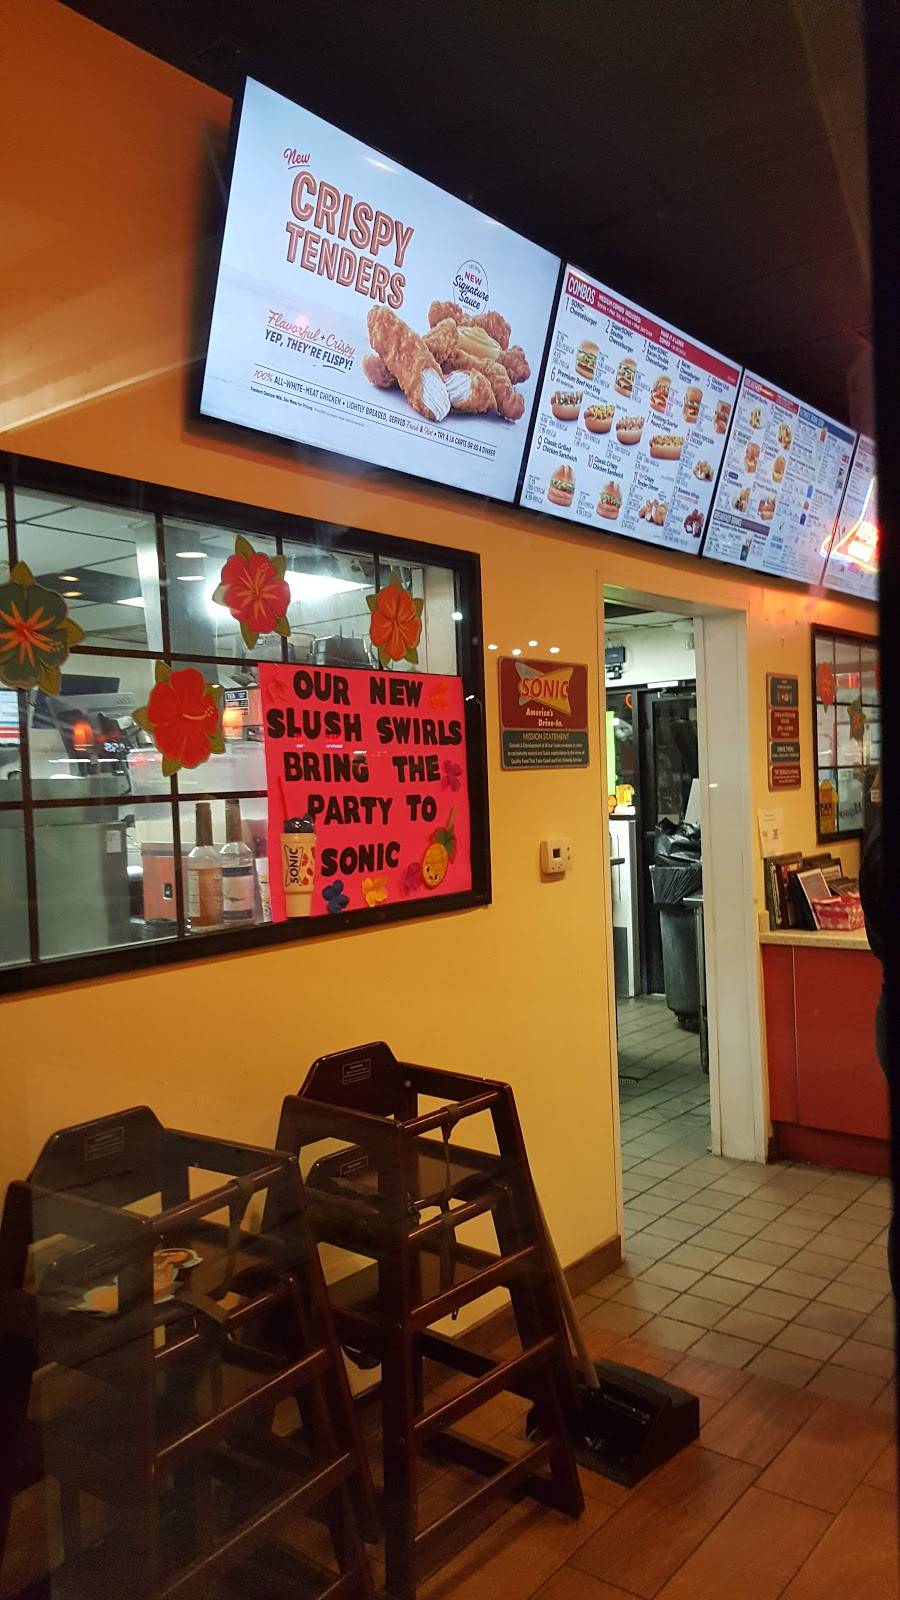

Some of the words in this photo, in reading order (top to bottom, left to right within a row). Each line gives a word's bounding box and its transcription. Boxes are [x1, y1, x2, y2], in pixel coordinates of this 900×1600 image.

[283, 148, 312, 166] New
[290, 171, 414, 268] CRISPY
[286, 222, 406, 309] TENDERS
[453, 275, 489, 302] Signature
[464, 271, 483, 286] NEW
[458, 291, 481, 310] Sauce
[568, 277, 595, 304] COMBOS
[571, 299, 585, 311] SONIC
[569, 306, 597, 326] Cheeseburger
[267, 309, 320, 342] Flavorful
[326, 335, 356, 359] Crispy
[608, 335, 634, 353] Cheeseburger
[265, 329, 284, 347] YEP,
[286, 336, 322, 359] THEY'RE
[323, 351, 354, 371] FLISPY!
[550, 367, 556, 381] 6
[557, 369, 576, 382] Premium
[576, 378, 586, 386] Beef
[585, 382, 593, 390] Hot
[592, 386, 601, 395] Dog
[273, 376, 319, 398] ALL-WHITE-MEAT
[319, 391, 342, 406] CHICKEN
[346, 400, 366, 413] LIGHTLY
[389, 415, 405, 427] SERVED
[536, 435, 543, 450] 9
[543, 437, 557, 448] Classic
[558, 442, 571, 453] Grilled
[542, 445, 558, 456] Chicken
[558, 450, 577, 462] Sandwich
[594, 456, 606, 466] Classic
[606, 460, 618, 471] Crispy
[592, 463, 607, 473] Chicken
[607, 468, 624, 479] Sandwich
[293, 665, 350, 706] OUR
[369, 671, 423, 708] NEW
[521, 678, 569, 698] SONIC
[526, 707, 554, 717] America's
[266, 708, 362, 742] SLUSH
[376, 716, 463, 745] SWIRLS
[523, 732, 543, 741] MISSION
[543, 732, 569, 741] STATEMENT
[283, 751, 369, 782] BRING
[392, 754, 441, 782] THE
[307, 794, 393, 825] PARTY
[406, 794, 438, 822] TO
[290, 846, 299, 885] SONIC
[320, 841, 401, 877] SONIC
